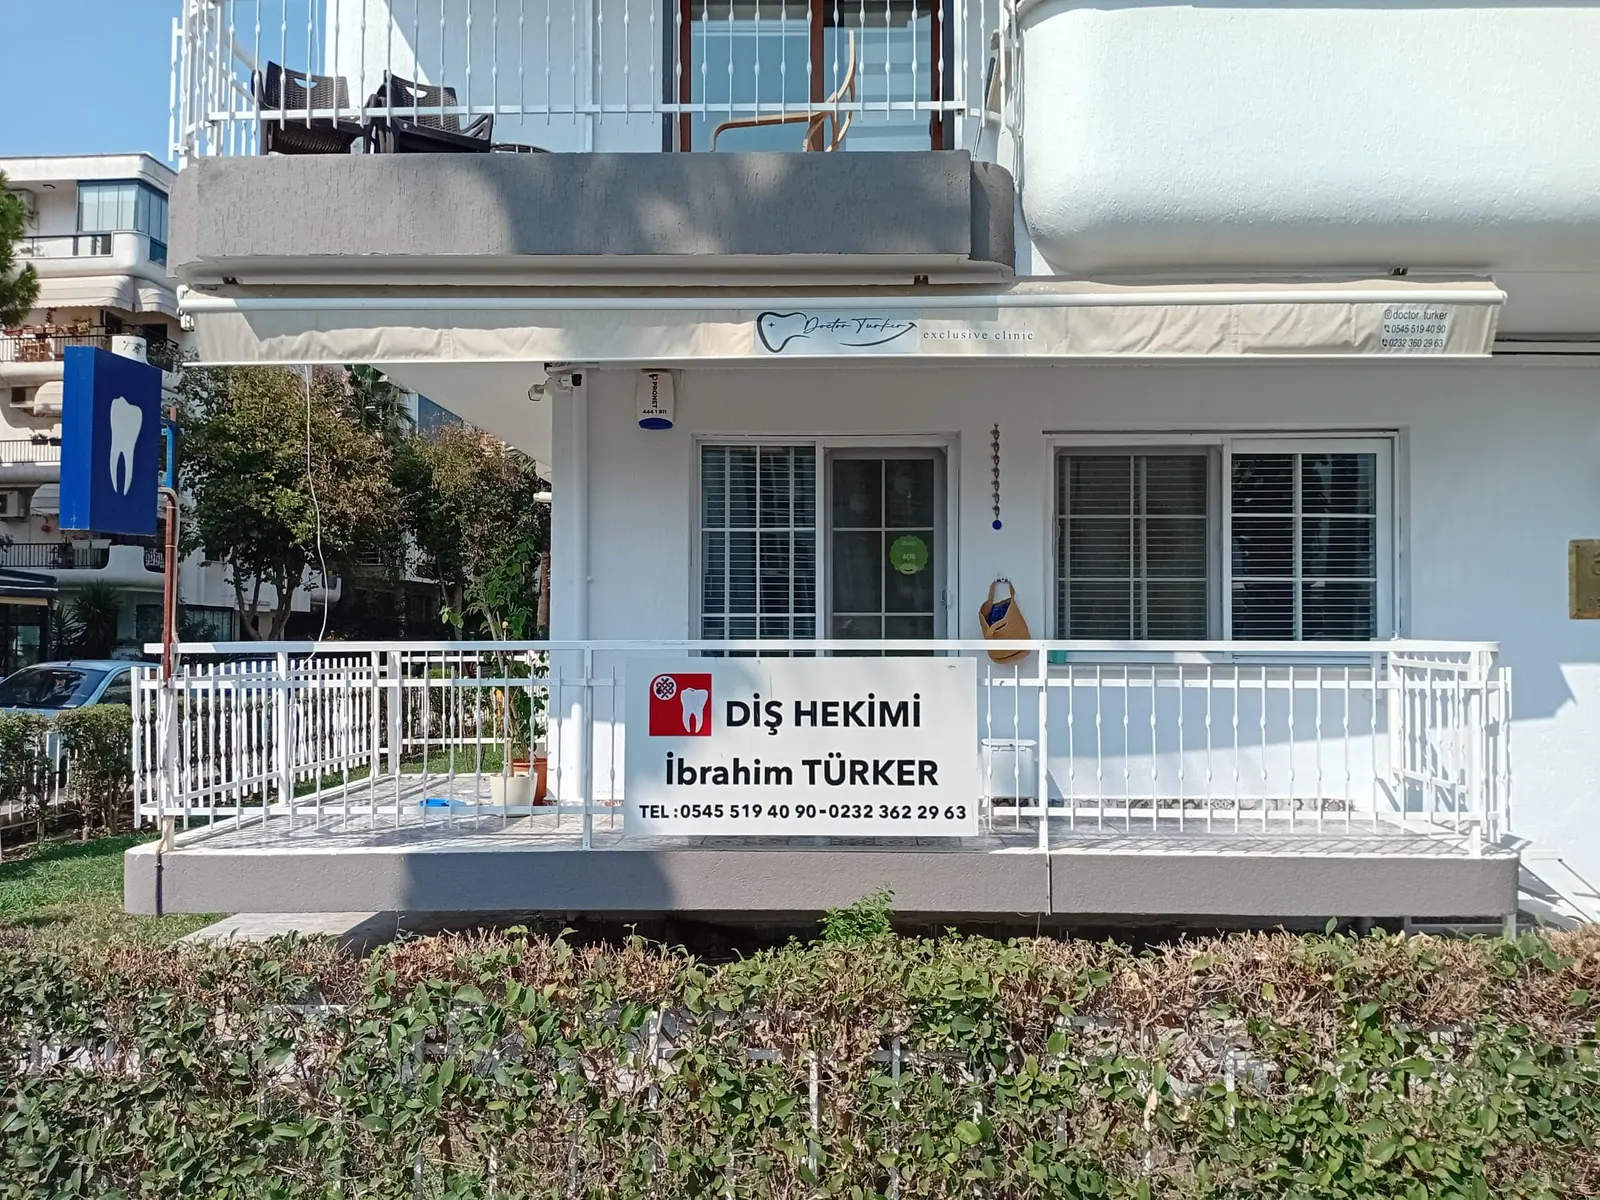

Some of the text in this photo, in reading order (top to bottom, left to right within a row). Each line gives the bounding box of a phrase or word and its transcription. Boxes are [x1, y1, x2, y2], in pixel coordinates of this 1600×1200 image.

[803, 315, 850, 335] Doctor
[1391, 324, 1446, 334] 0545 519 40 90
[923, 330, 1034, 341] exclusive clinic
[1388, 338, 1407, 348] 0232
[1423, 338, 1433, 348] 29
[1433, 338, 1444, 348] 63
[726, 692, 921, 736] DİŞ HEKİMİ
[665, 751, 939, 786] İbrahim TÜRKER
[729, 804, 763, 819] 519
[767, 804, 790, 819] 40
[878, 805, 912, 820] 362
[917, 805, 940, 820] 29
[944, 805, 967, 820] 63
